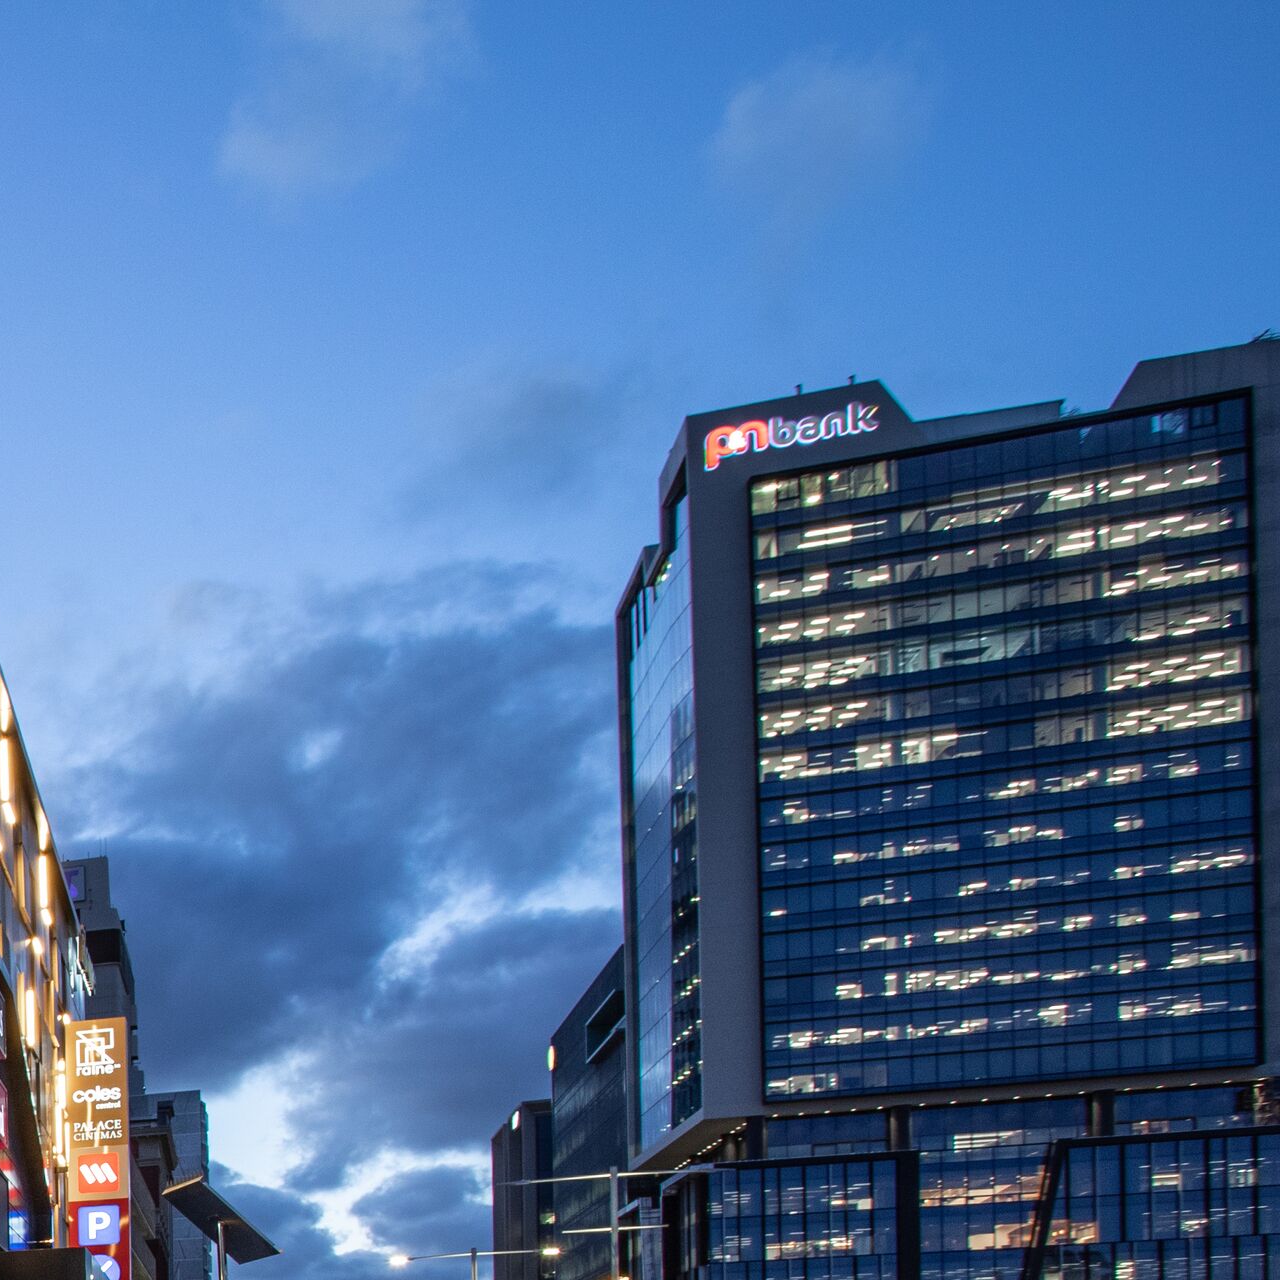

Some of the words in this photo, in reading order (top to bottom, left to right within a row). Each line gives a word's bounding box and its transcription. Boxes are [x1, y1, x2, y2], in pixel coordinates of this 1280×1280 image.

[75, 1064, 114, 1077] raine
[72, 1085, 122, 1103] coles
[73, 1119, 122, 1133] PALACE
[73, 1129, 123, 1142] CINEMAS
[88, 1211, 111, 1240] P
